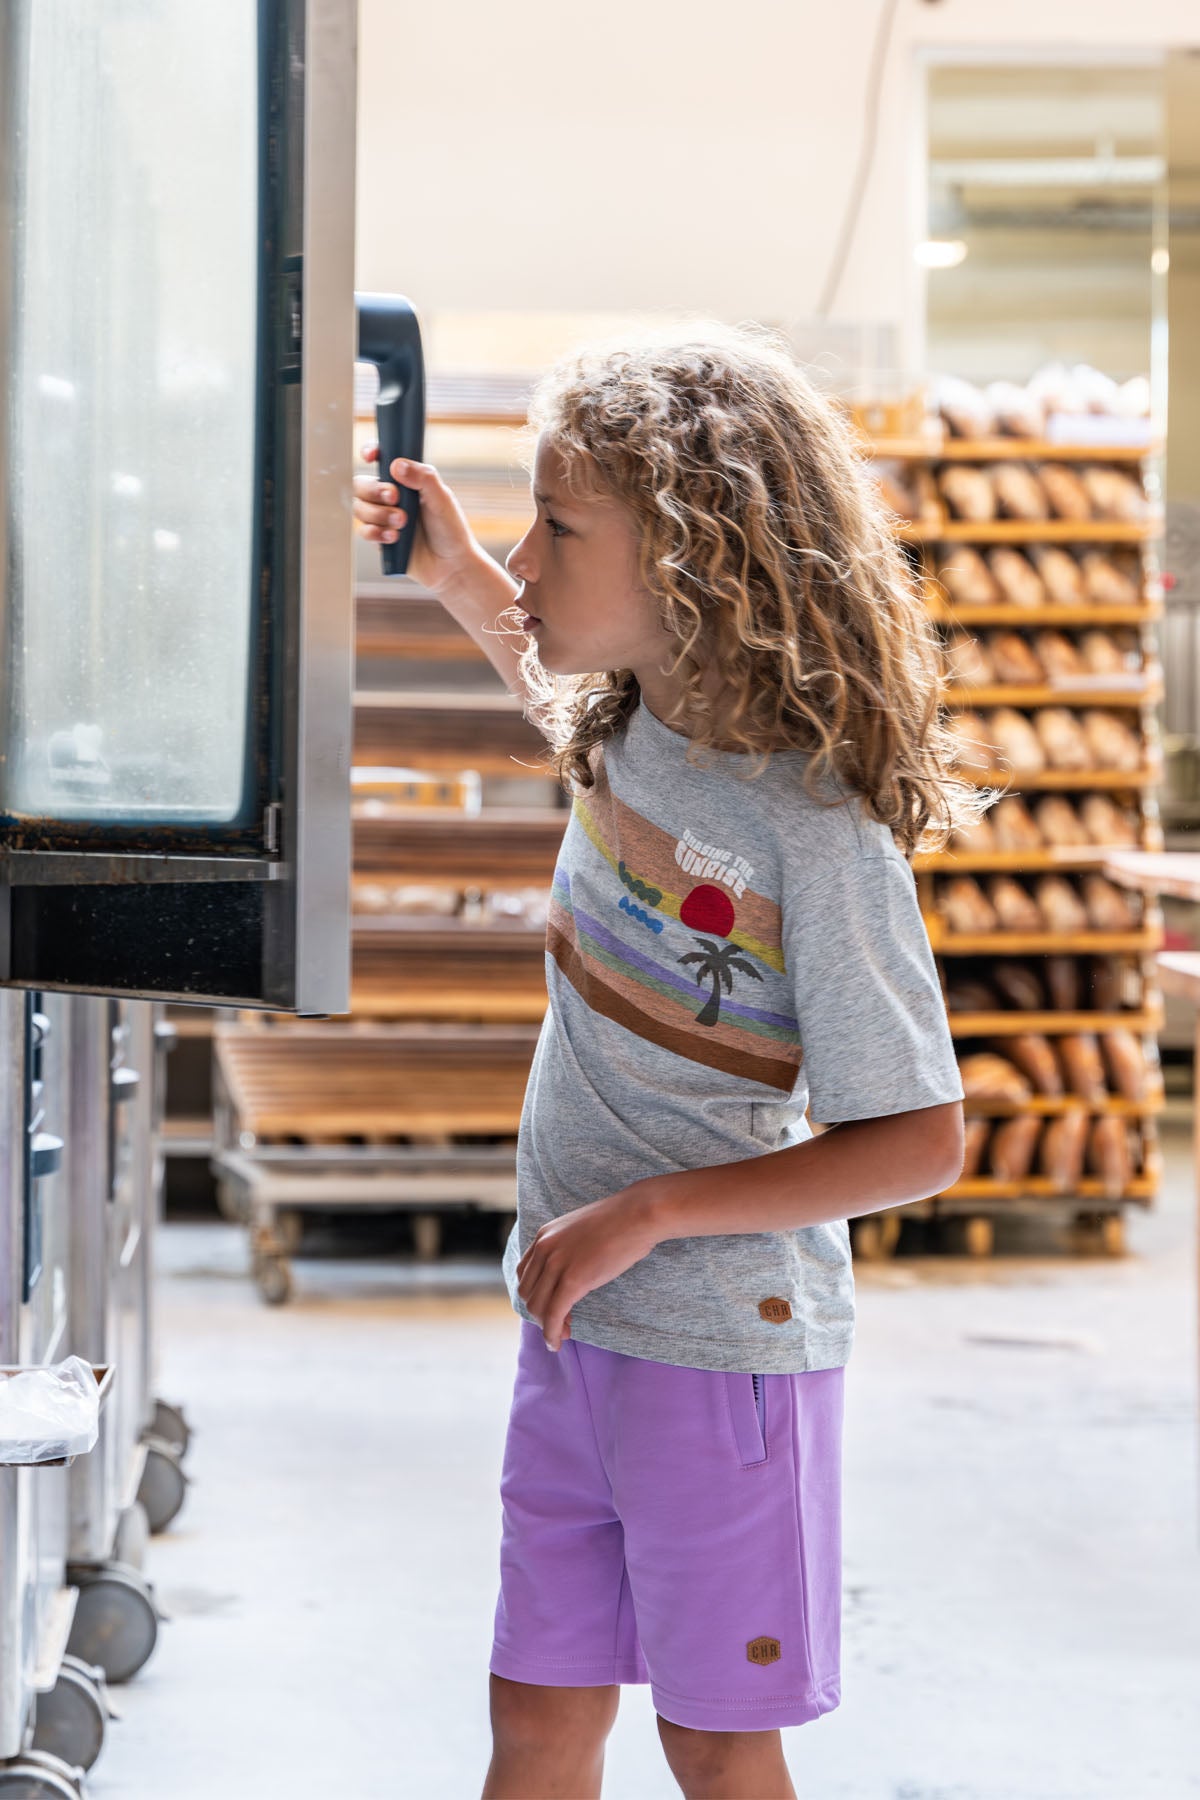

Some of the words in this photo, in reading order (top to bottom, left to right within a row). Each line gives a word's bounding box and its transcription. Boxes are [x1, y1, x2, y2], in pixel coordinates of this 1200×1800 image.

[675, 840, 746, 899] SUNRISE
[683, 829, 733, 862] CHASING
[733, 856, 754, 881] THE
[752, 1644, 778, 1659] CHR
